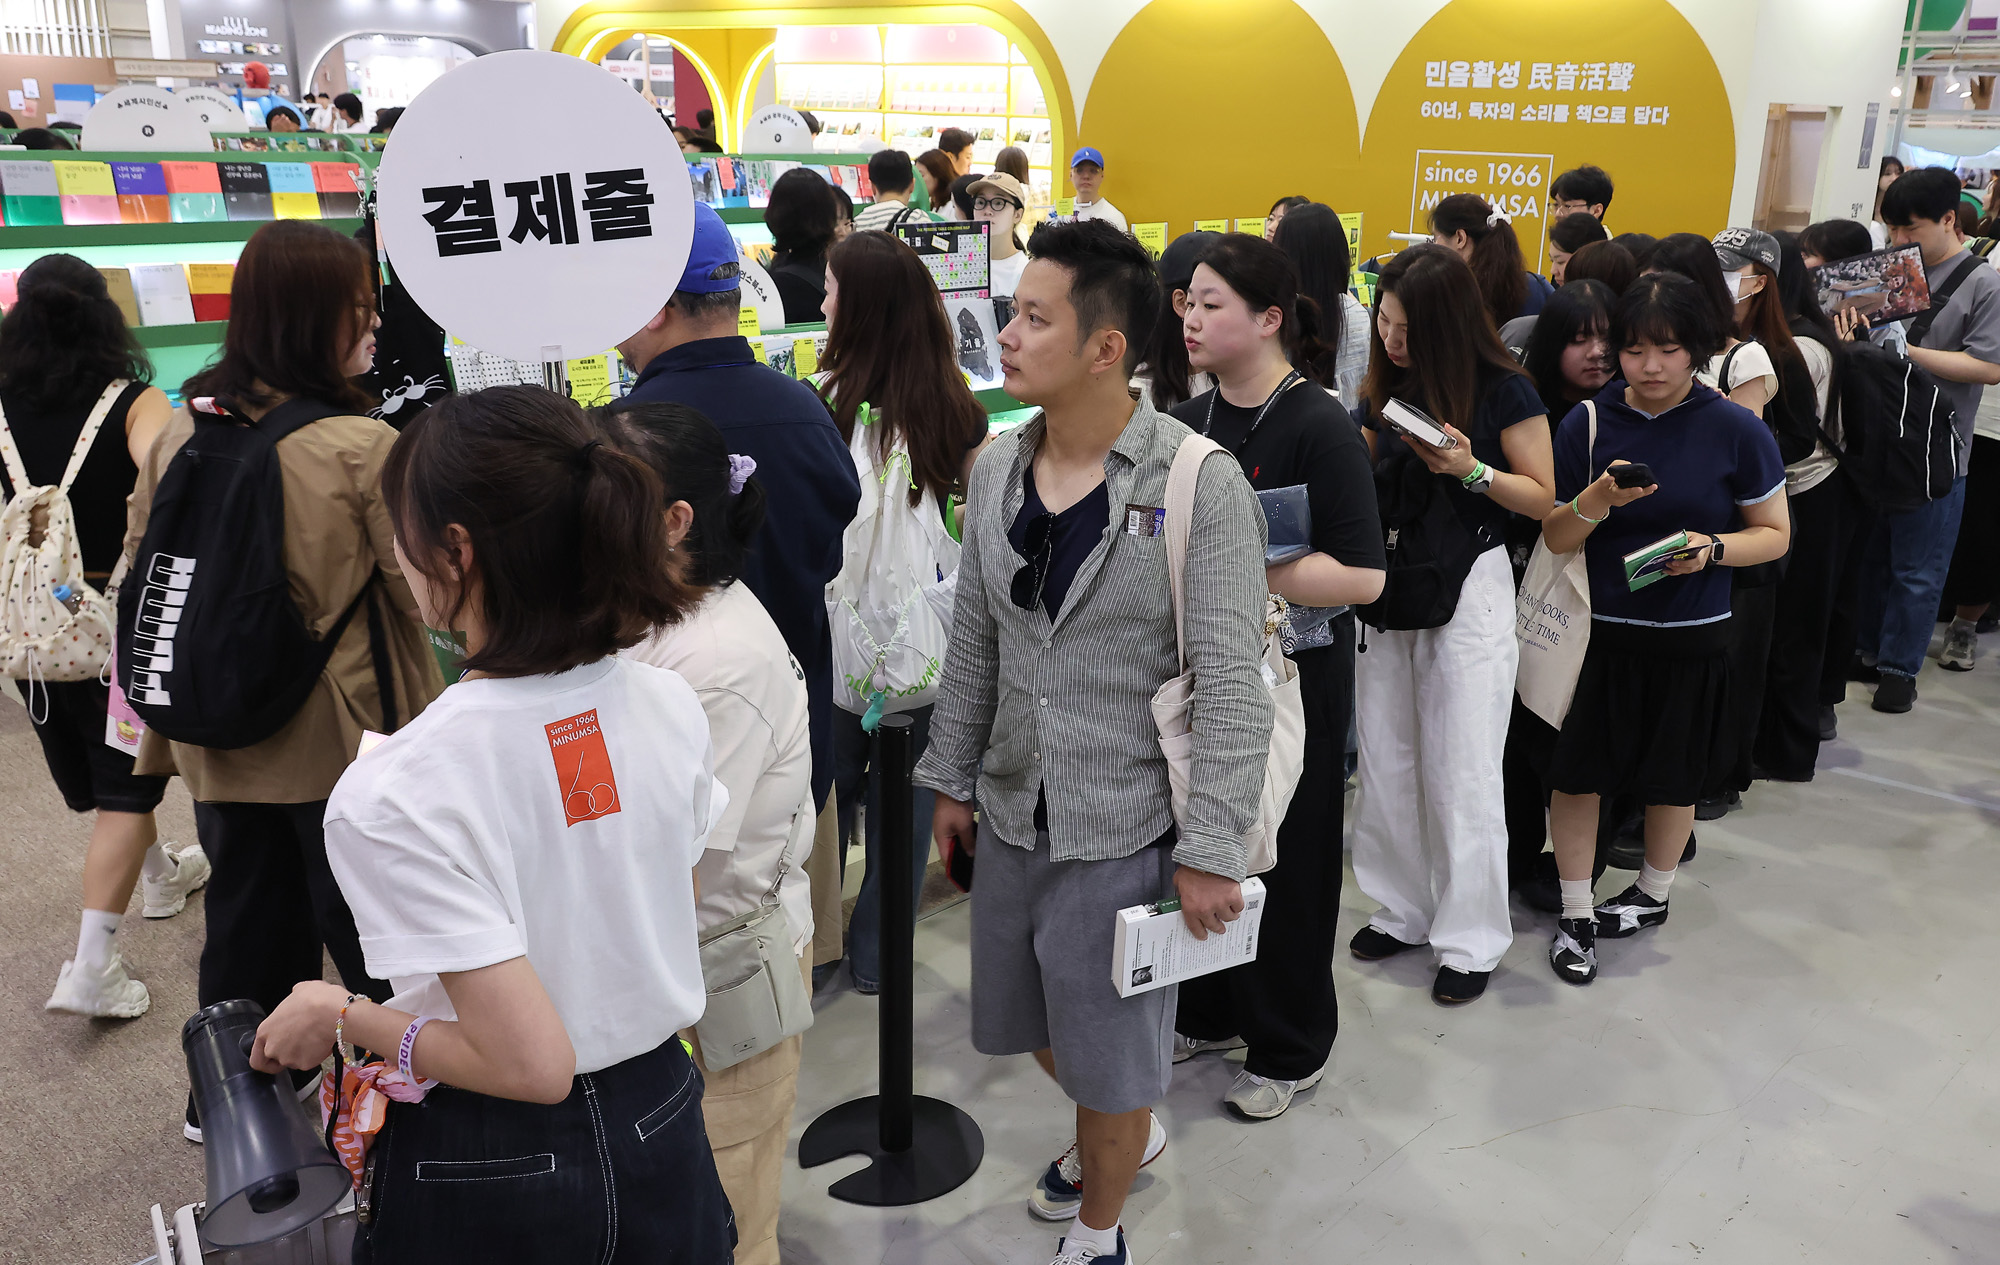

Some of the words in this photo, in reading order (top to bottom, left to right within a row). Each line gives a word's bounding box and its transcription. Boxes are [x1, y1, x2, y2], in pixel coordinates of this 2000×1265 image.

[1424, 60, 1521, 89] 민음활성
[1527, 61, 1636, 92] 民音活聲
[1420, 100, 1463, 121] 60년,
[1468, 101, 1516, 121] 독자의
[1520, 103, 1570, 124] 소리를
[1575, 104, 1627, 125] 책으로
[1633, 105, 1671, 126] 담다
[1424, 160, 1478, 185] since
[1486, 162, 1543, 188] 1966
[422, 168, 654, 257] 결제줄
[128, 552, 197, 706] PUMA
[1537, 623, 1561, 646] TIME
[550, 723, 573, 736] since
[574, 712, 596, 727] 1966
[552, 724, 600, 748] MINUMSA
[400, 1023, 418, 1068] PRIDE
